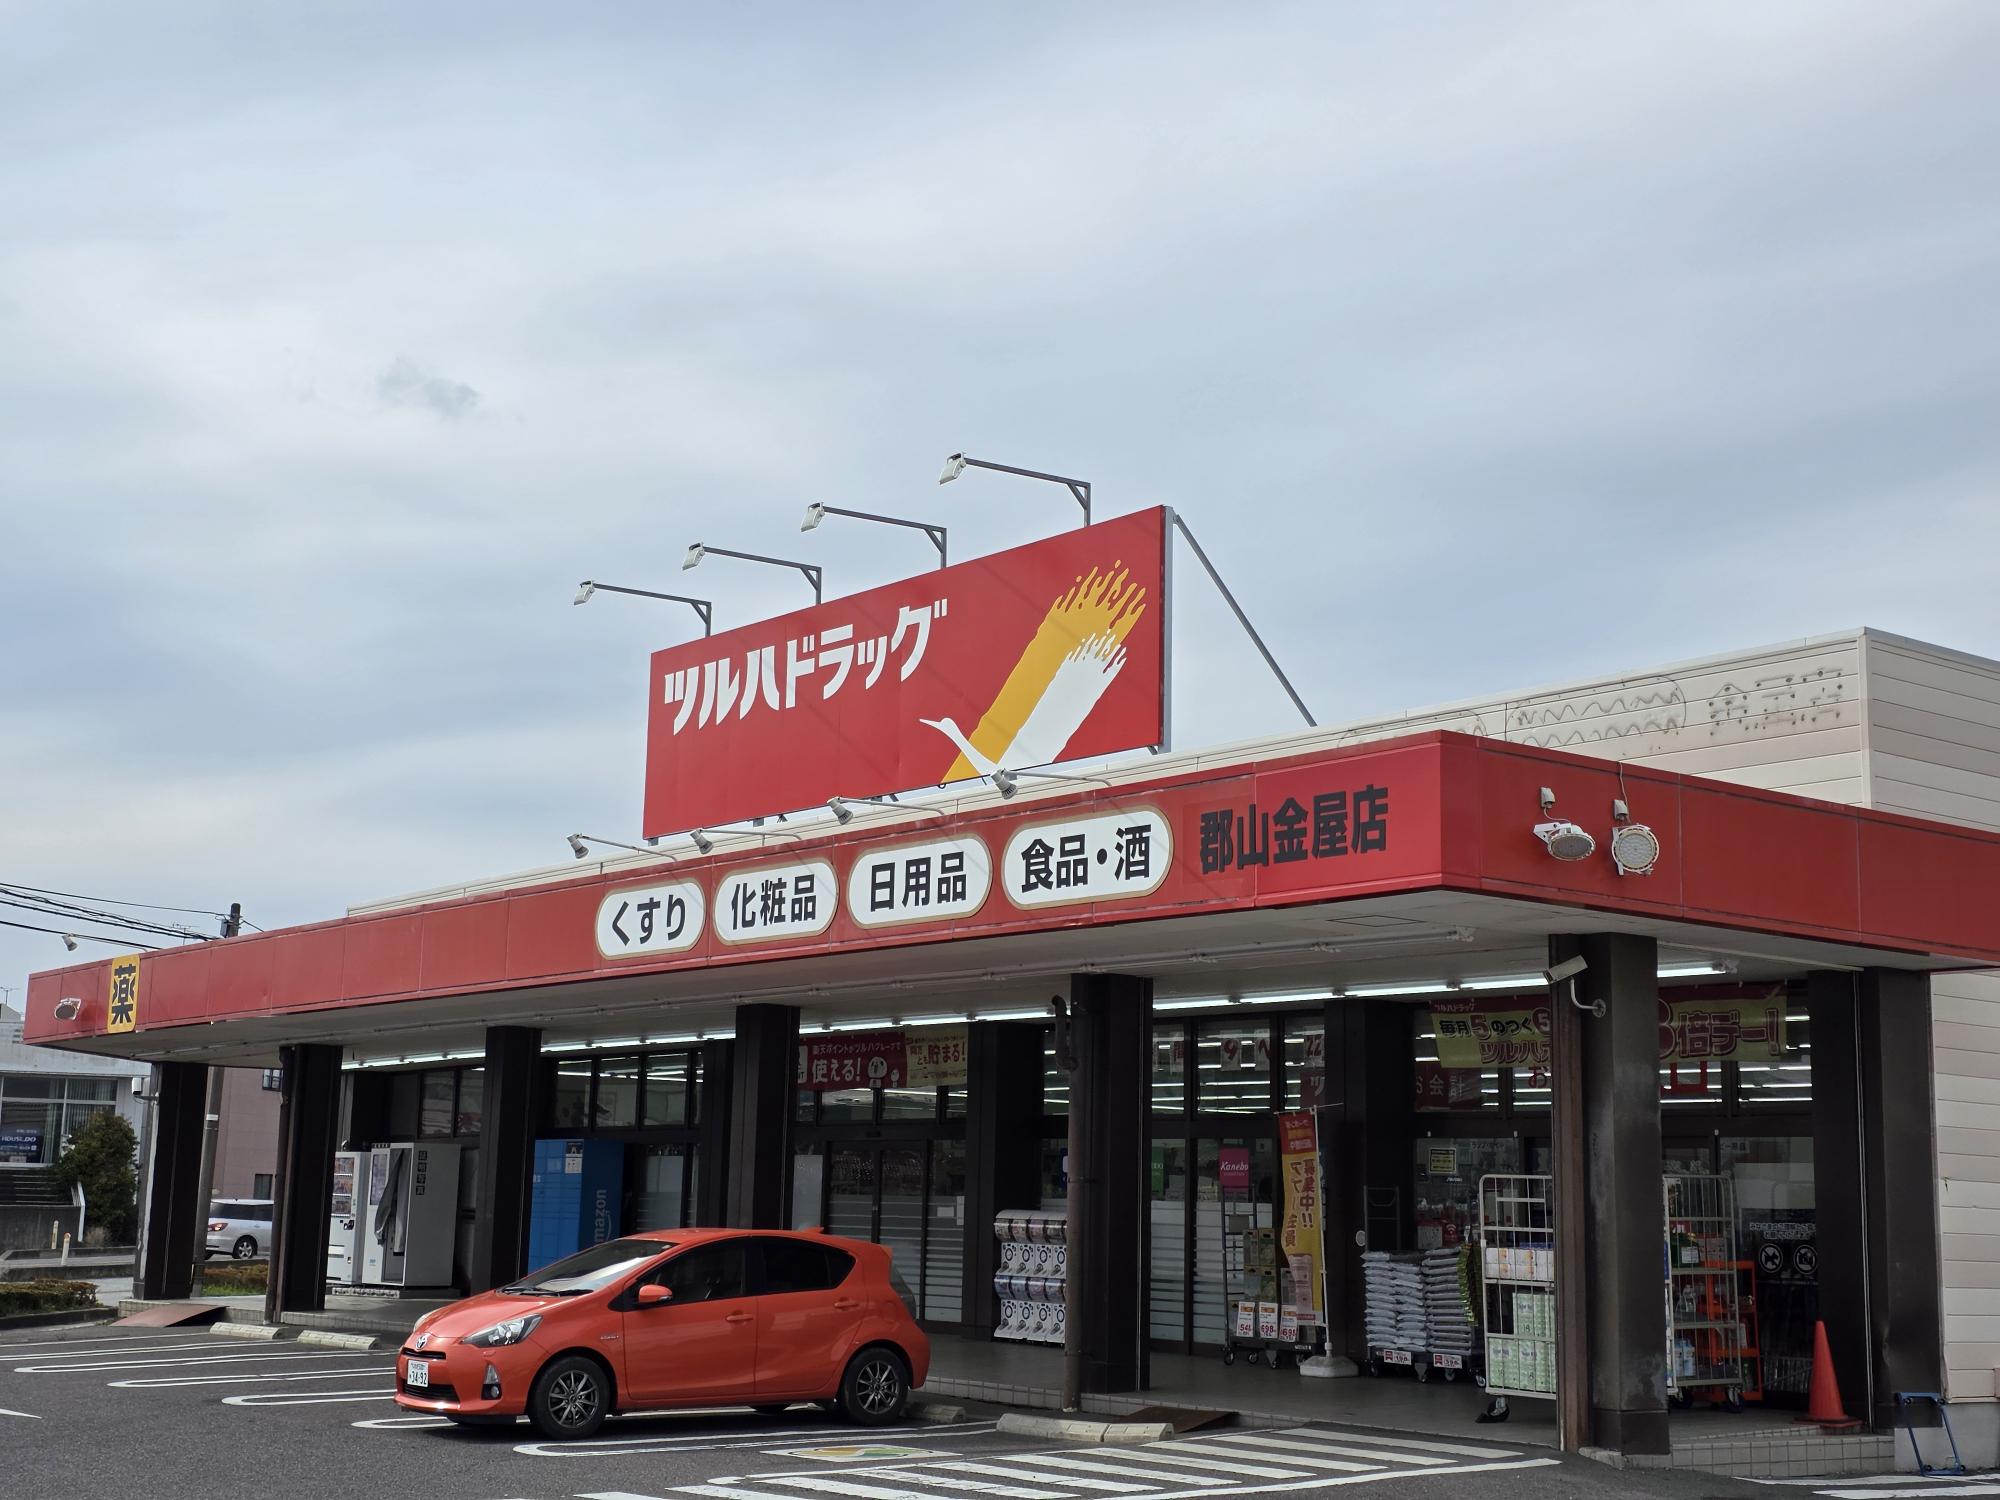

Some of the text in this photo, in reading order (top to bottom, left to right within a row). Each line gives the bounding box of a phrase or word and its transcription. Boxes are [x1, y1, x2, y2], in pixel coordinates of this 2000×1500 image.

[664, 598, 949, 734] ツルハドラッグ
[1020, 823, 1152, 892] 食品・酒
[1198, 783, 1390, 874] 郡山金屋店
[730, 872, 817, 930] 化粧品
[870, 850, 968, 912] 日用品
[611, 893, 687, 946] くすり
[111, 964, 136, 1025] 薬
[1220, 1162, 1249, 1171] Kanebo
[593, 1189, 608, 1242] mazon
